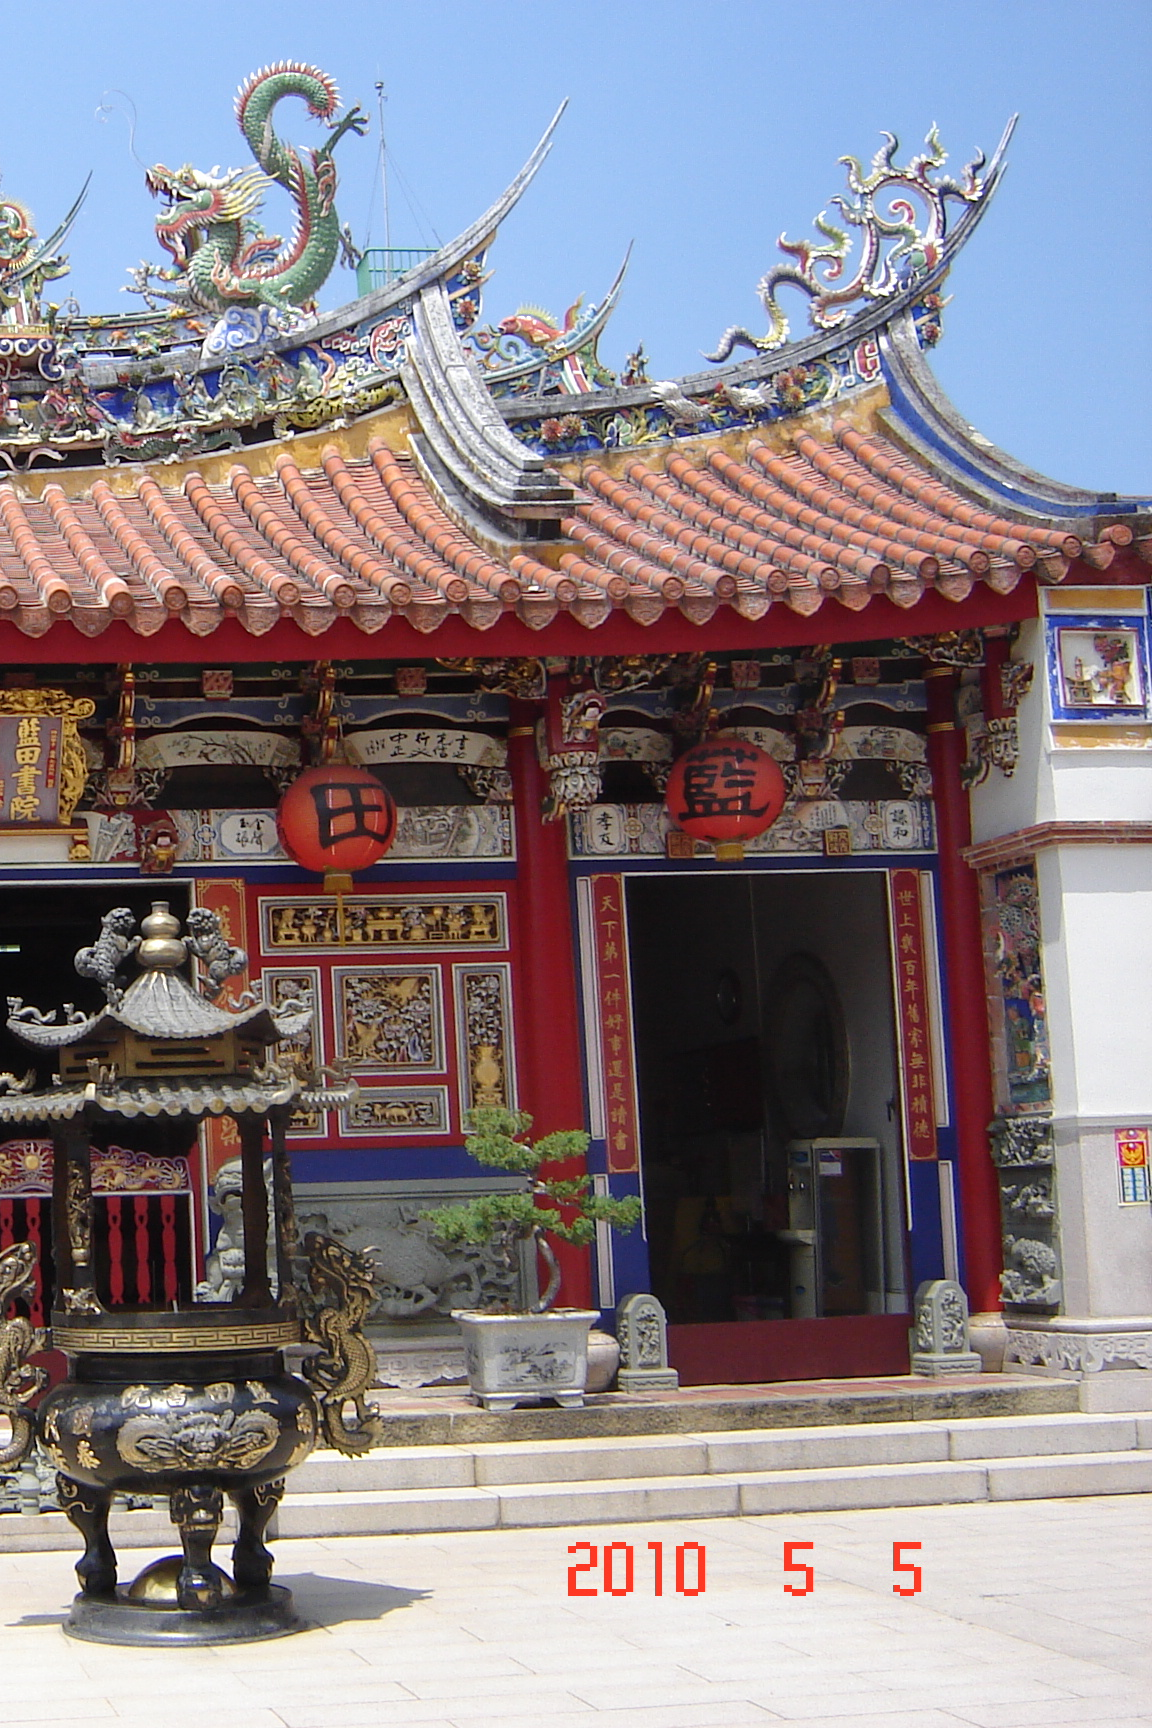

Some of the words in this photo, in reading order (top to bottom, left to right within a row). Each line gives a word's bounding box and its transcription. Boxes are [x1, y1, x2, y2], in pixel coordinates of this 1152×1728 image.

[9, 717, 43, 822] 藍田書院
[678, 746, 772, 823] 藍
[309, 781, 392, 850] 田
[599, 895, 629, 1152] 天下第一件好事還是讀書
[120, 1381, 279, 1409] 藍田書院
